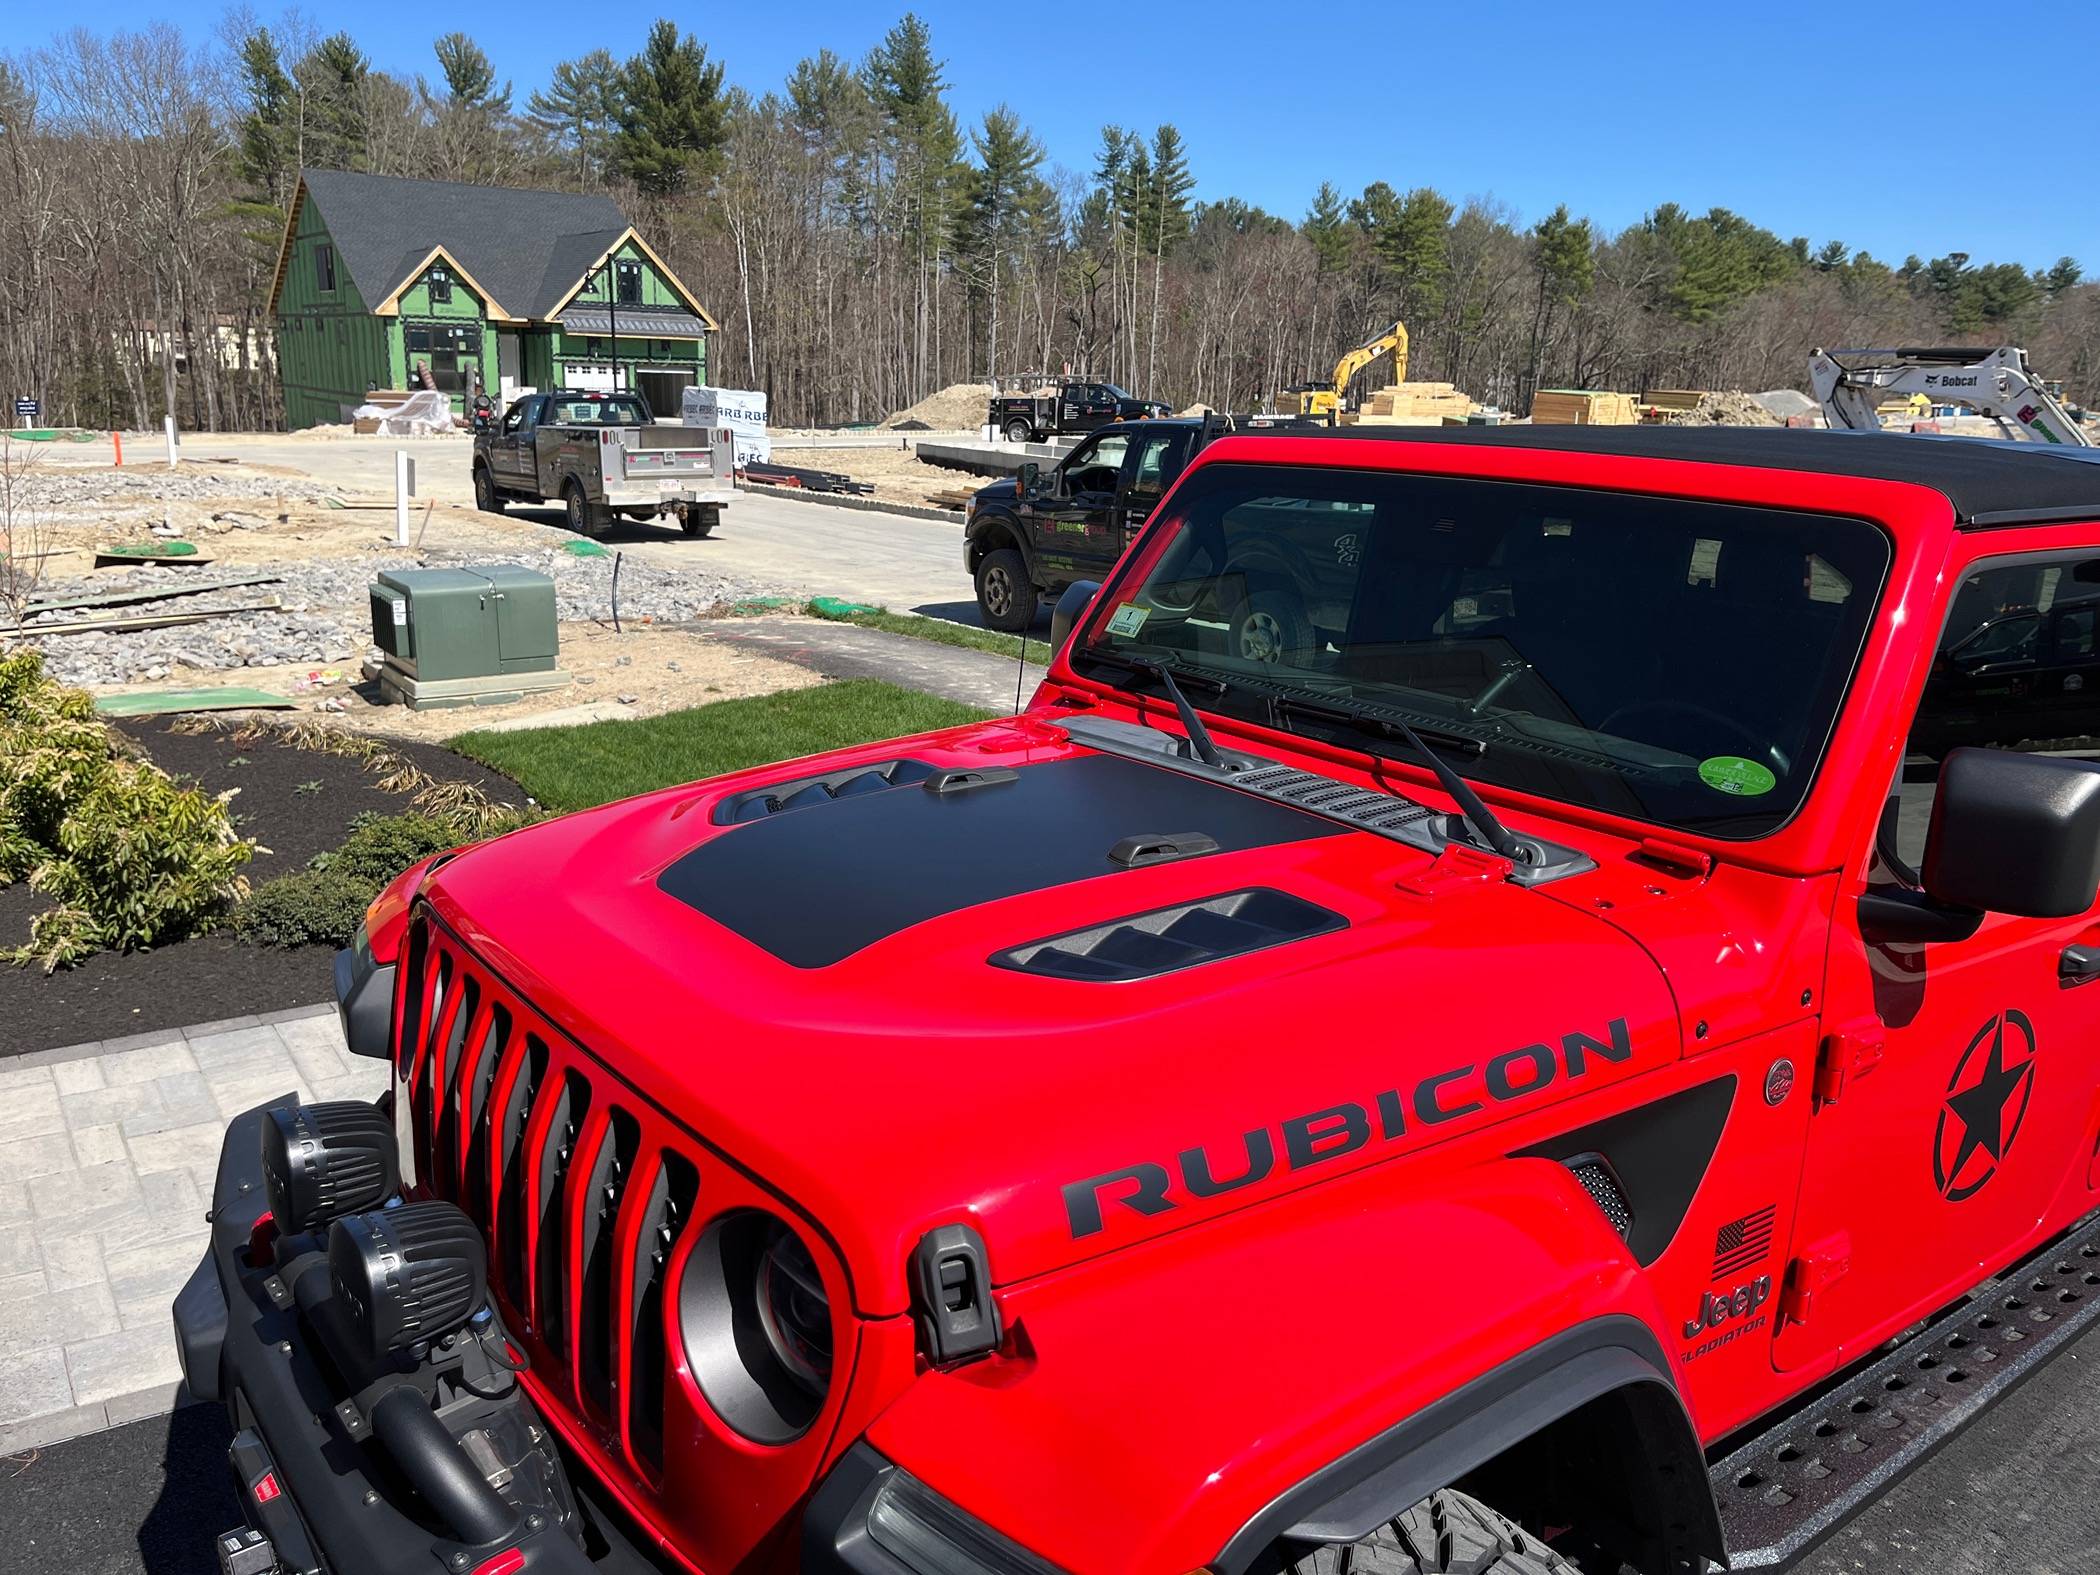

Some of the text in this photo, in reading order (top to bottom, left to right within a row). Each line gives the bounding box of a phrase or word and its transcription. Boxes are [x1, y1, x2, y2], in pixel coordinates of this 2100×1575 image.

[1941, 374, 1979, 387] Bobcat
[1127, 611, 1133, 621] 1
[1060, 1017, 1633, 1240] RUBICON
[1683, 1275, 1771, 1340] Jeep
